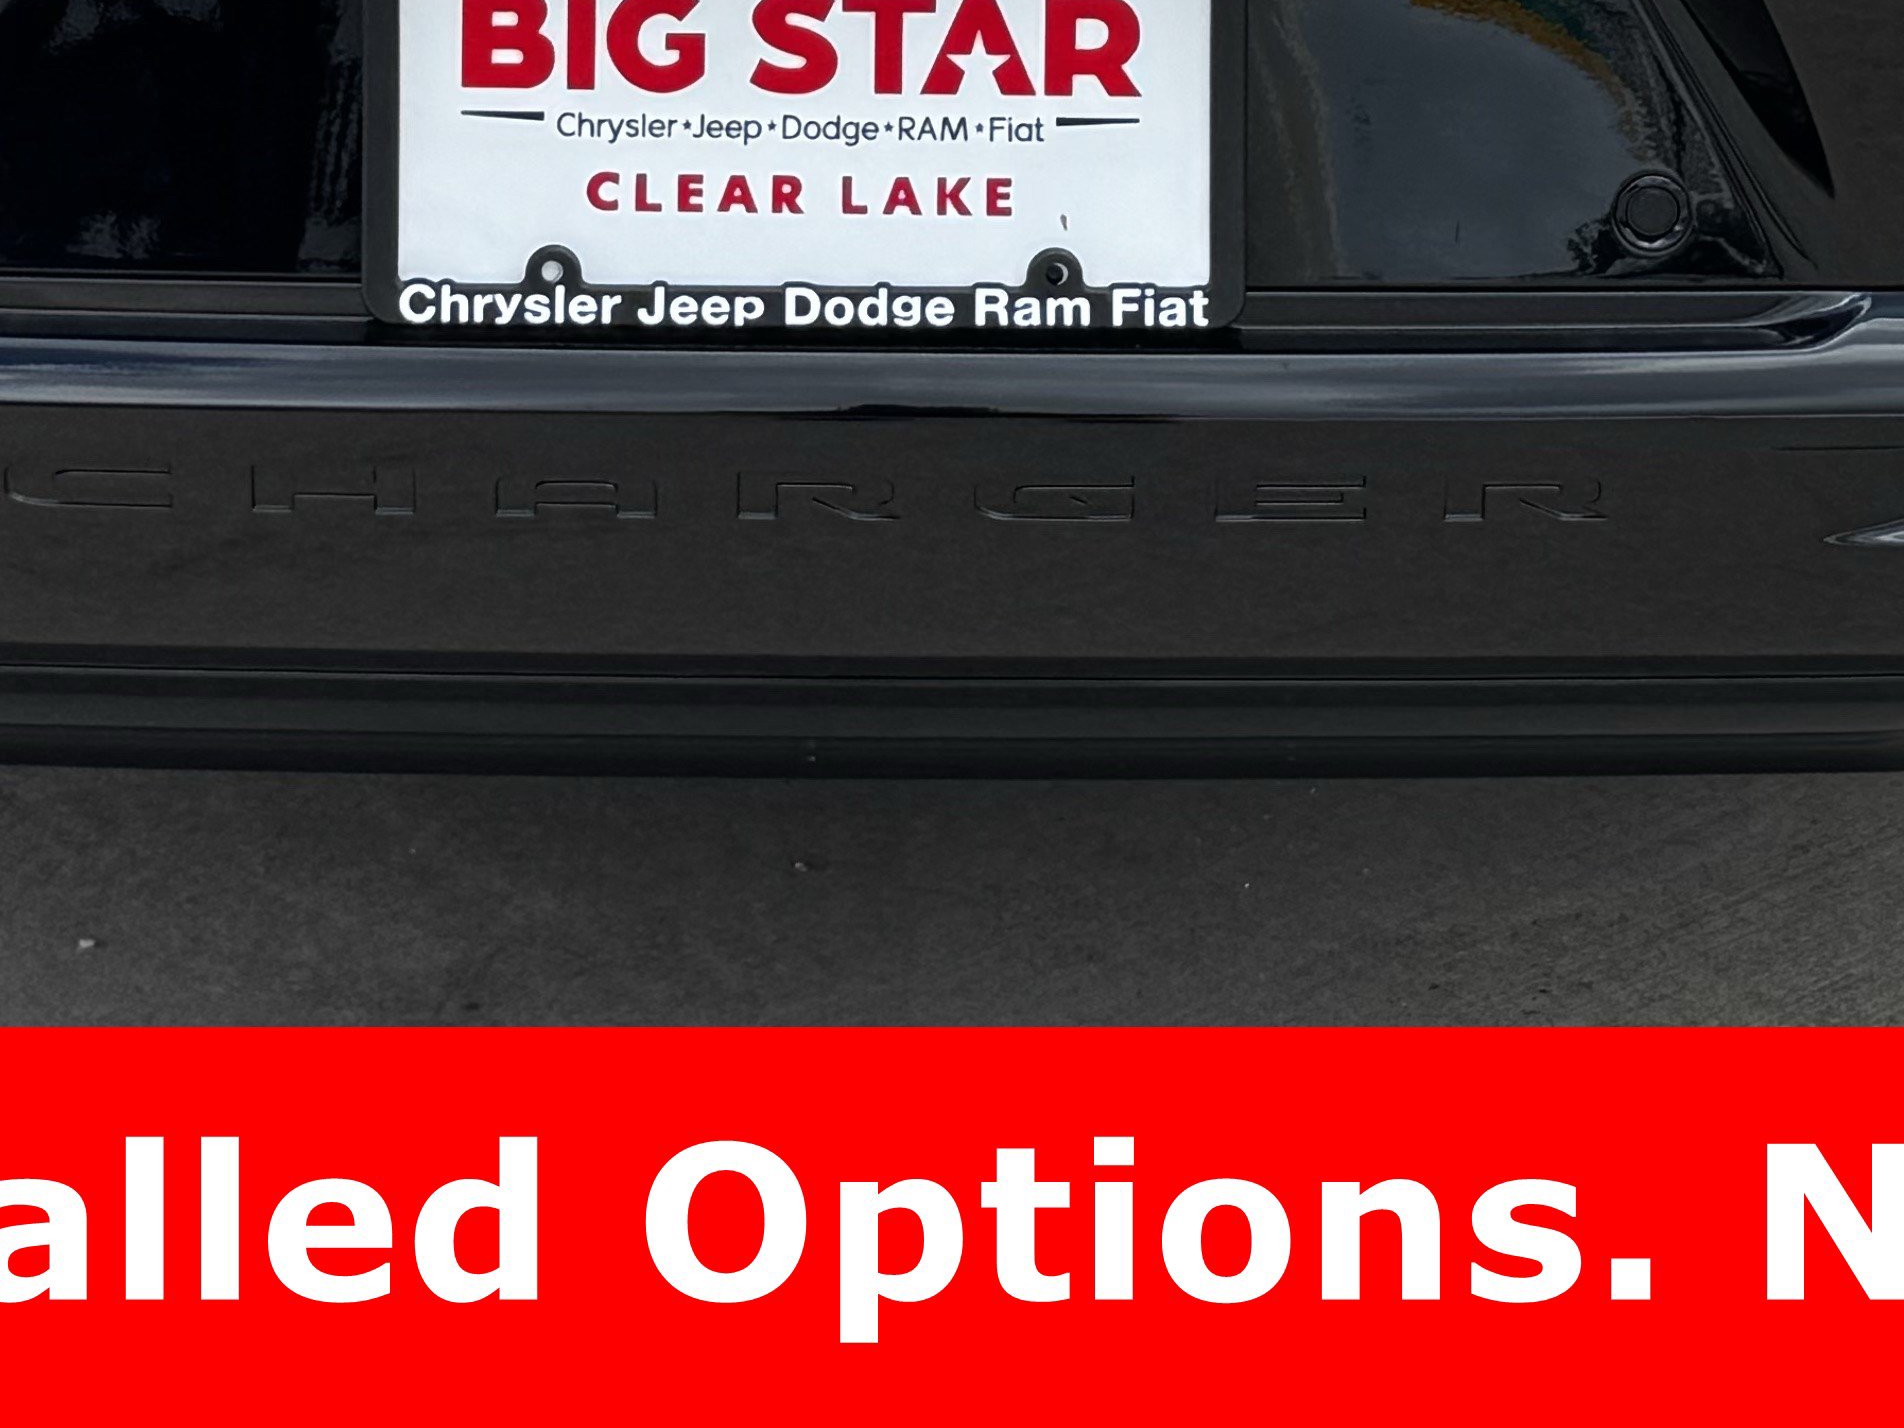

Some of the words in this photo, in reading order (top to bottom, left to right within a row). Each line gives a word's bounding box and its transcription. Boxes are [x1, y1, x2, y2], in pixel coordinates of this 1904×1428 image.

[586, 170, 805, 214] CLEAR
[841, 175, 1013, 217] LAKE
[398, 282, 623, 327] Chrysler
[636, 285, 766, 328] Jeep
[784, 286, 956, 328] Dodge
[974, 287, 1092, 328] Ram
[1111, 287, 1210, 329] Fiat
[2, 462, 1610, 523] CHARGER
